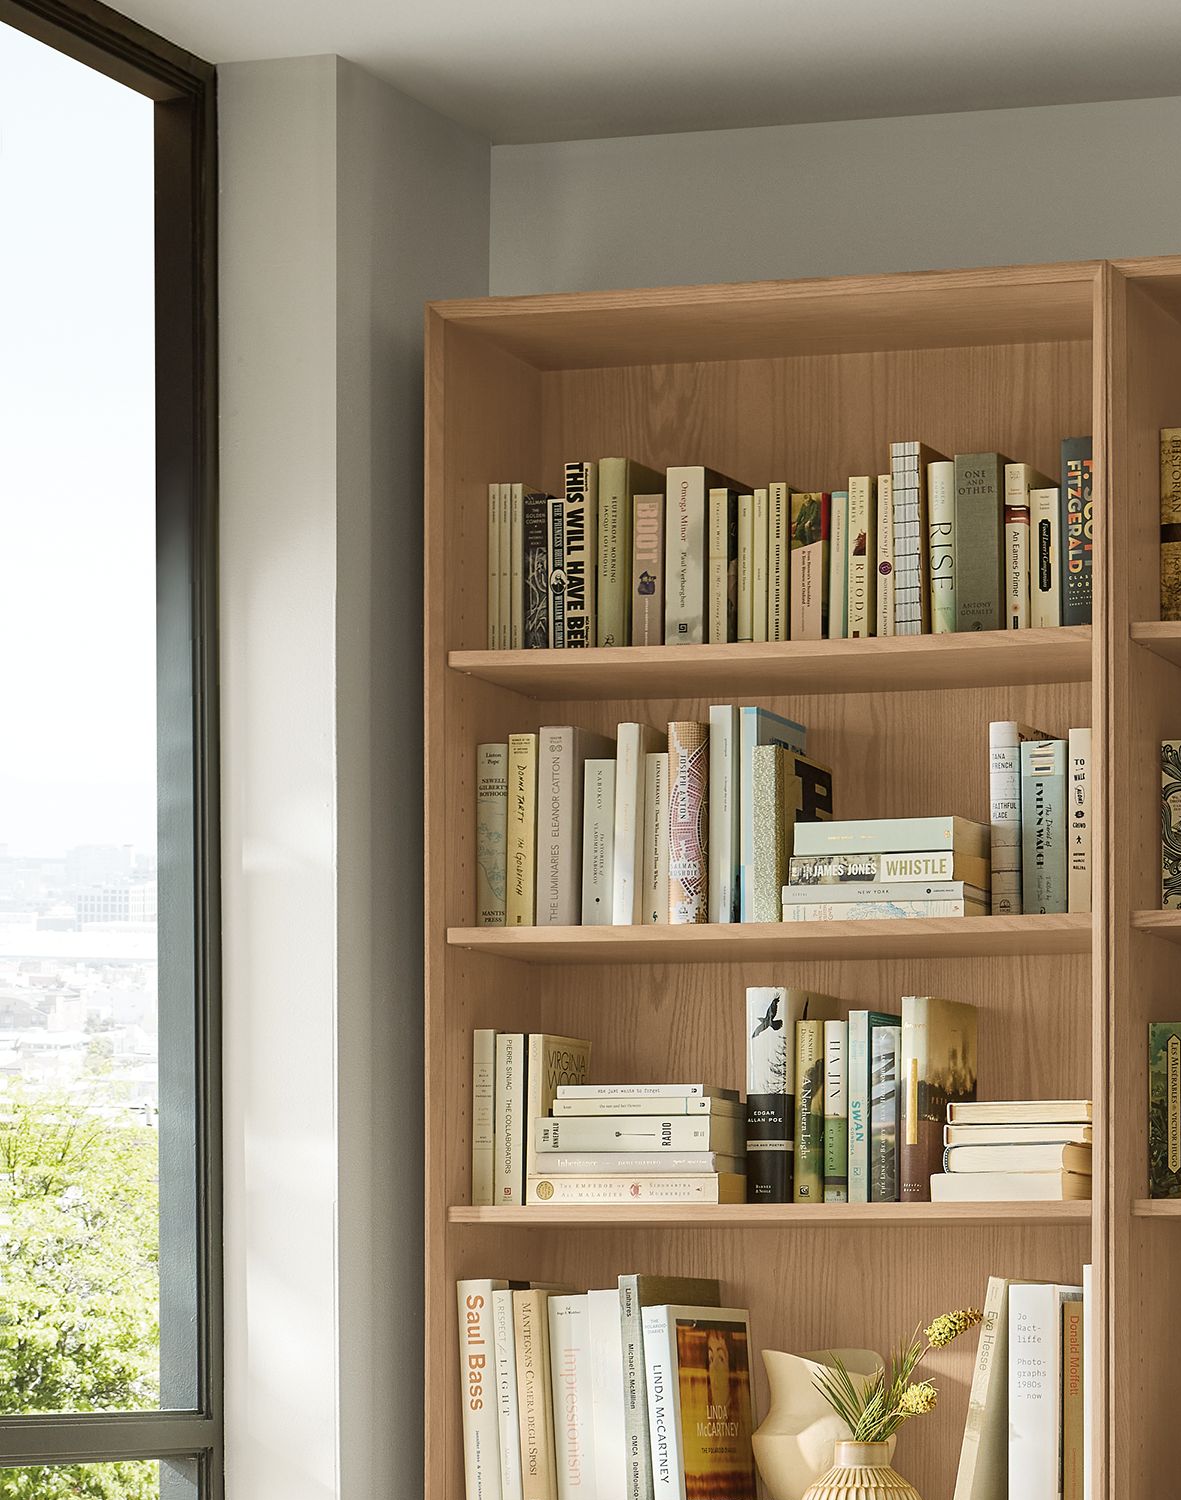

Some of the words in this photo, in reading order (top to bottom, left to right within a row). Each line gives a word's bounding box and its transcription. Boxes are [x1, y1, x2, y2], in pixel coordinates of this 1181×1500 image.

[566, 463, 585, 503] THIS
[958, 488, 994, 496] OTHER
[965, 470, 986, 478] ONE
[1171, 439, 1181, 513] HISTORIAN
[678, 481, 689, 512] Omega
[566, 509, 585, 556] WILL
[679, 515, 689, 542] Minor
[1012, 531, 1020, 541] An
[1067, 460, 1082, 573] FITZGERALD
[680, 552, 688, 567] Paul
[930, 522, 954, 593] RISE
[1012, 544, 1020, 569] Eames
[566, 561, 585, 611] HAVE
[678, 568, 687, 608] Verhaeghen
[854, 563, 865, 622] RHODA
[1012, 572, 1020, 597] Primer
[566, 616, 585, 648] BEE
[551, 757, 560, 794] CATTON
[551, 795, 560, 837] ELEANOR
[550, 845, 560, 901] LUMINARIES
[813, 864, 844, 877] JAMES
[847, 862, 877, 875] JONES
[886, 859, 947, 877] WHISTLE
[801, 1077, 811, 1086] A
[800, 1088, 812, 1131] Northern
[851, 1101, 864, 1142] SWAN
[504, 1114, 512, 1174] COLLABORATORS
[662, 1122, 672, 1147] RADIO
[799, 1134, 812, 1159] Light
[466, 1295, 485, 1345] Saul
[985, 1311, 999, 1331] Eva
[1069, 1315, 1080, 1353] Donald
[625, 1288, 633, 1317] Linhares
[629, 1379, 637, 1410] McMillen
[978, 1335, 996, 1371] Hesse
[468, 1354, 487, 1411] Bass
[652, 1364, 664, 1403] LINDA
[1069, 1357, 1080, 1396] Moffett
[560, 1348, 582, 1487] Impressionism
[706, 1405, 728, 1419] LINDA
[655, 1406, 670, 1484] McCARTNEY
